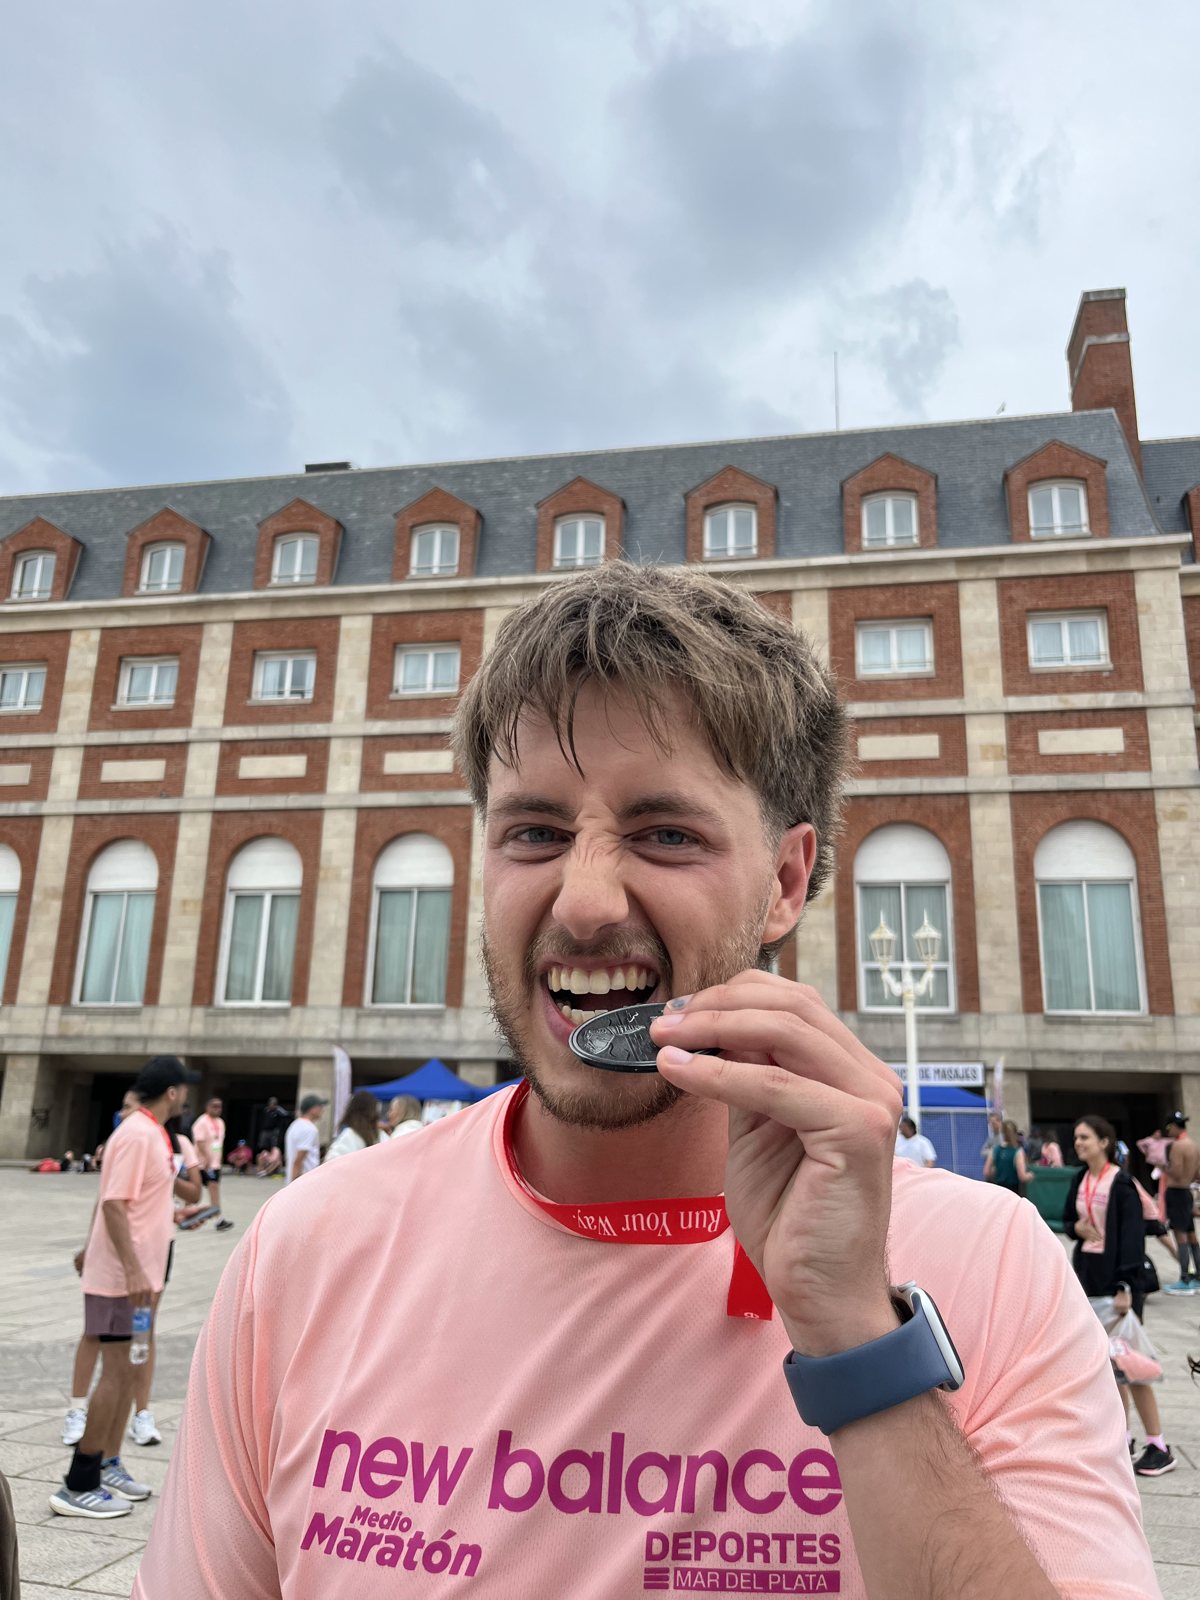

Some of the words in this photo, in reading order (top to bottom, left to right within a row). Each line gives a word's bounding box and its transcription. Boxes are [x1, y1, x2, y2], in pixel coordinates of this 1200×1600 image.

[933, 1066, 977, 1081] MASAJES
[573, 1208, 618, 1237] Way.
[622, 1211, 673, 1237] Your
[680, 1209, 722, 1233] Run
[312, 1428, 474, 1506] new
[487, 1429, 844, 1516] balance
[349, 1505, 413, 1533] Medio
[300, 1511, 482, 1577] Maratón
[645, 1530, 841, 1565] DEPORTES
[676, 1570, 720, 1589] MAR
[725, 1572, 764, 1590] DEL
[769, 1573, 829, 1591] PLATA
